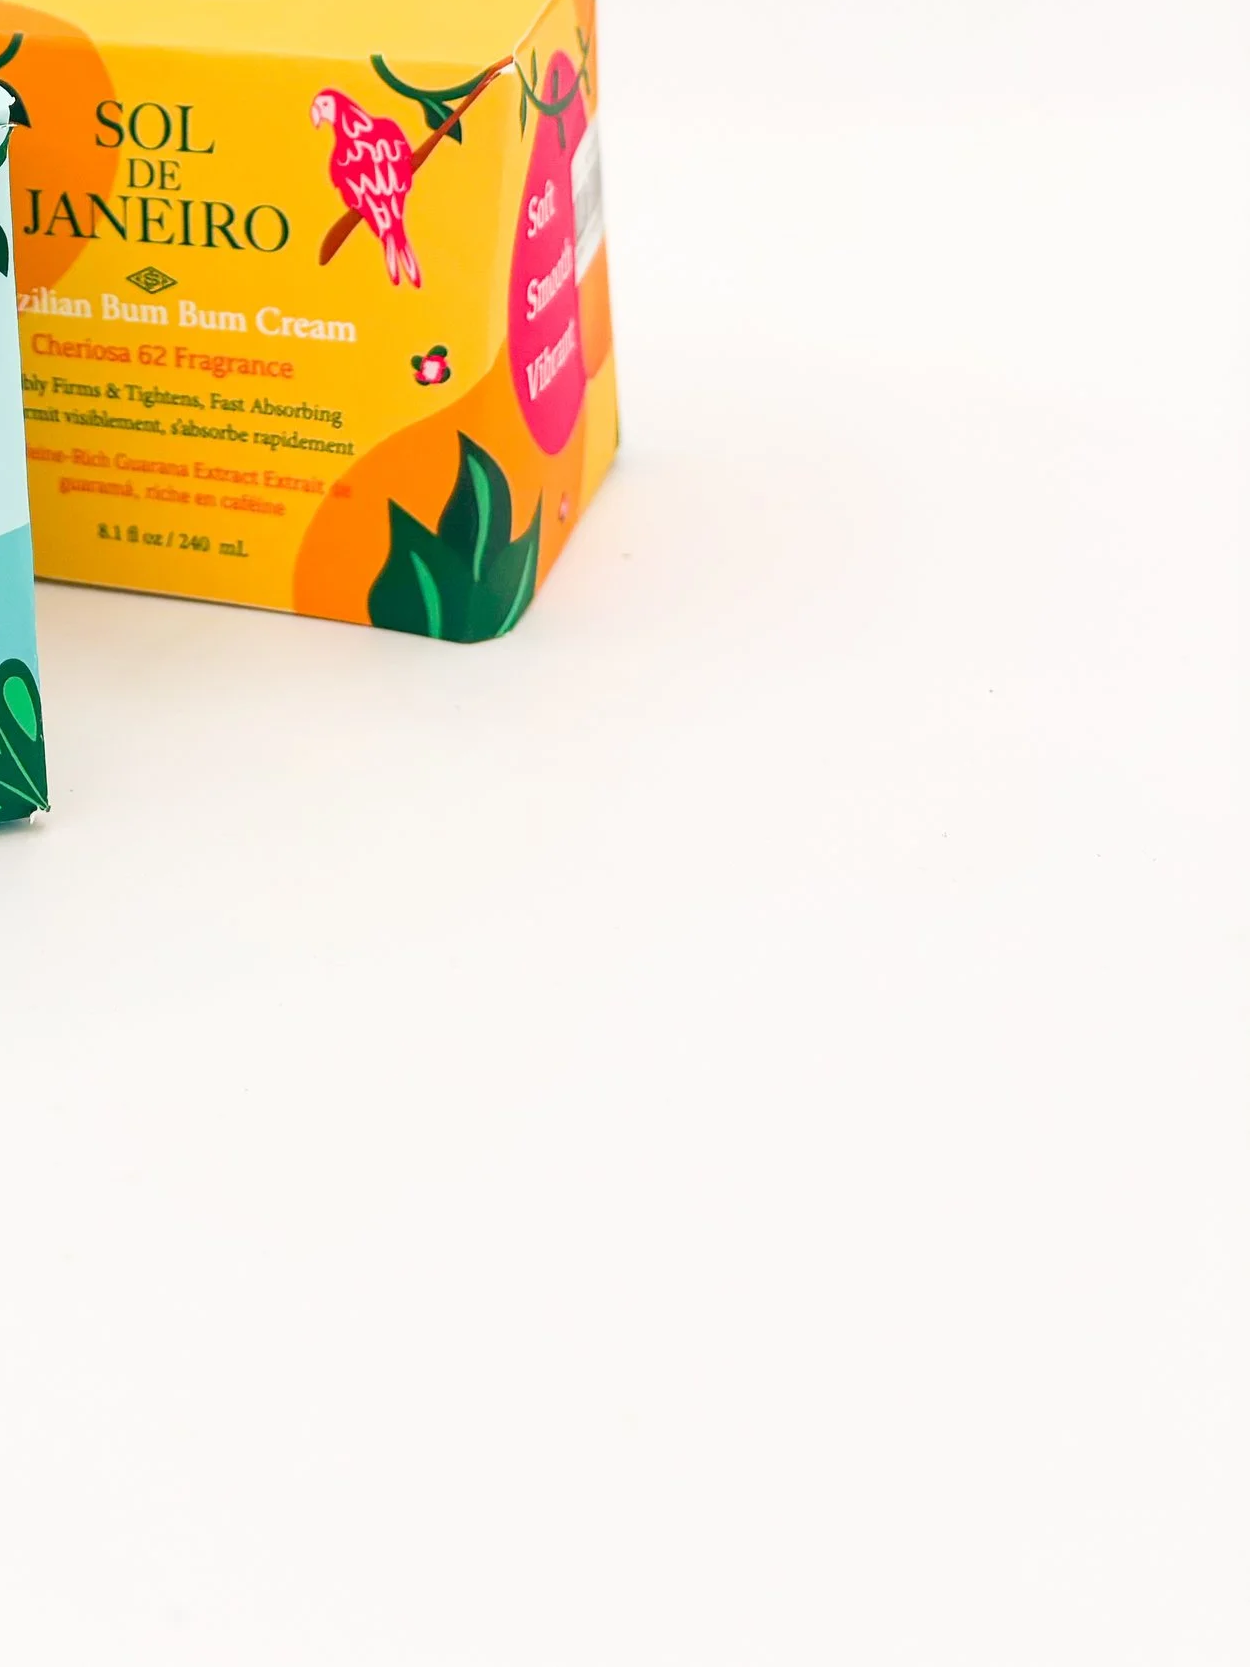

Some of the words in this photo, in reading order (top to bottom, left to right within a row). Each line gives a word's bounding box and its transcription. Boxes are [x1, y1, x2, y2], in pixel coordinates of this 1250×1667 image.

[95, 100, 215, 154] SOL
[127, 158, 181, 191] DE
[23, 188, 290, 252] JANEIRO
[527, 179, 555, 238] Soft
[18, 286, 92, 319] zilian
[101, 292, 169, 326] Bum
[178, 299, 247, 332] Bum
[255, 306, 357, 343] Cream
[32, 333, 131, 363] Cheriosa
[138, 344, 167, 366] 62
[175, 346, 294, 379] Fragrance
[526, 316, 576, 400] Vibrant
[52, 376, 101, 397] Firms
[106, 382, 121, 399] &
[125, 384, 205, 410] Tightens,
[210, 392, 245, 412] Fast
[250, 397, 343, 429] Absorbing
[253, 431, 355, 456] rapidement
[179, 533, 211, 552] 240
